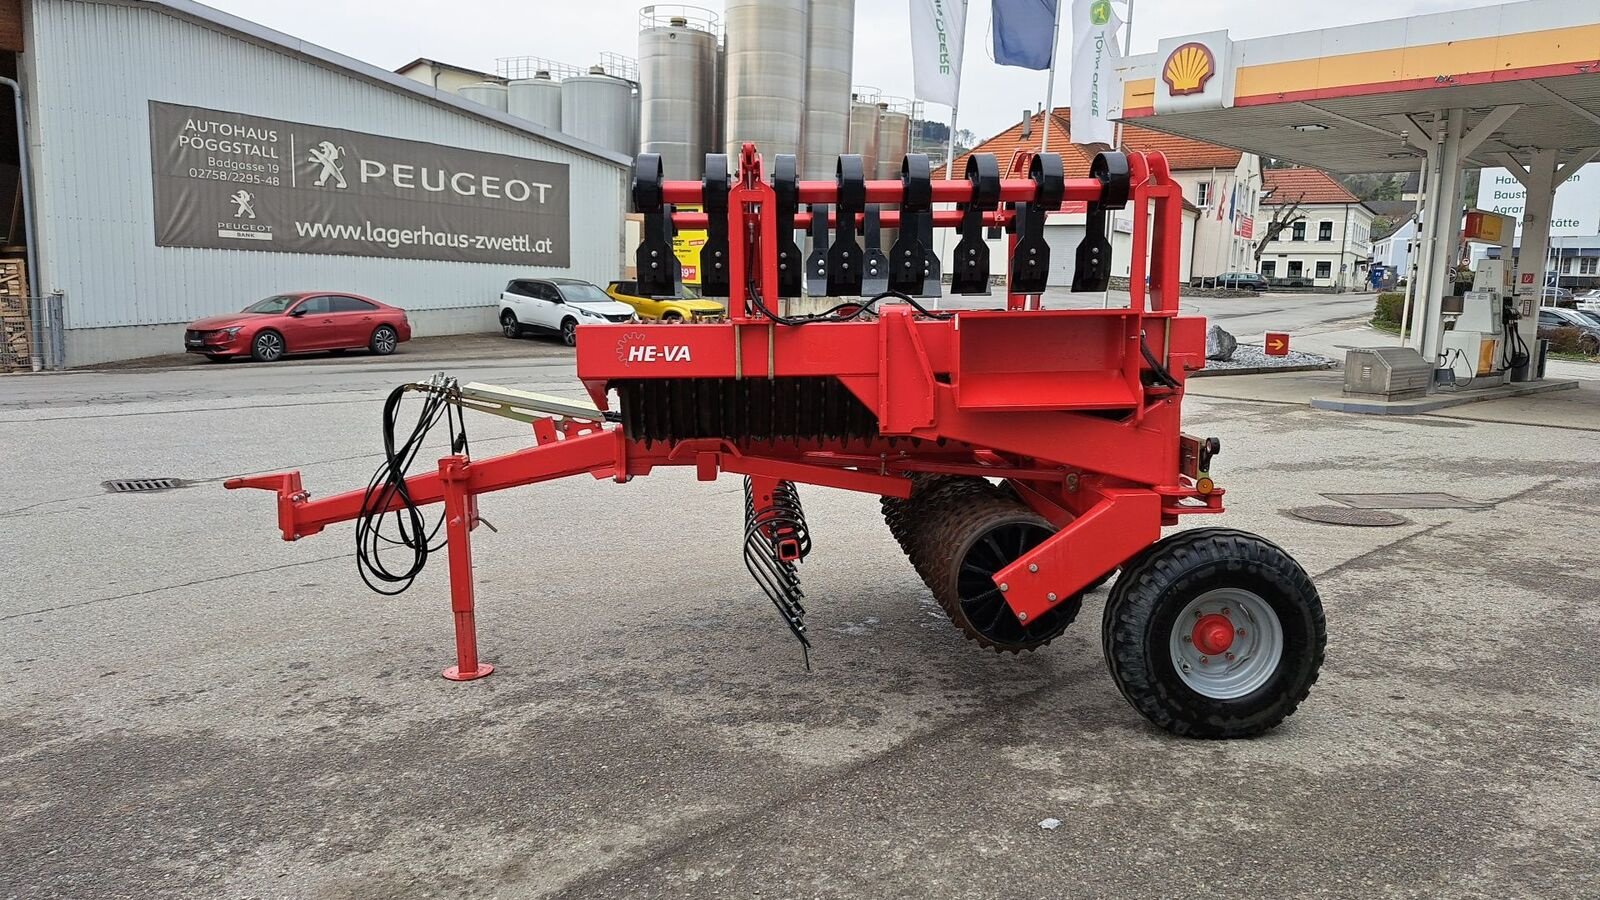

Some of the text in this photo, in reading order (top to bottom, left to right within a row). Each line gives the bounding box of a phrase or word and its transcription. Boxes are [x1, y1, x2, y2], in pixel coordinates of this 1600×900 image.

[184, 119, 278, 143] AUTOHAUS
[179, 133, 279, 159] PÖGGSTALL
[208, 157, 279, 173] Badgasse 19
[189, 168, 280, 186] 02758/2295-48
[360, 159, 552, 204] PEUGEOT
[1495, 176, 1520, 185] Hau
[1494, 190, 1527, 200] Baust
[217, 222, 272, 232] PEUGEOT
[1551, 218, 1580, 228] tätte
[295, 221, 553, 254] www.lagerhaus-zwettl.at
[628, 345, 691, 362] HE-VA
